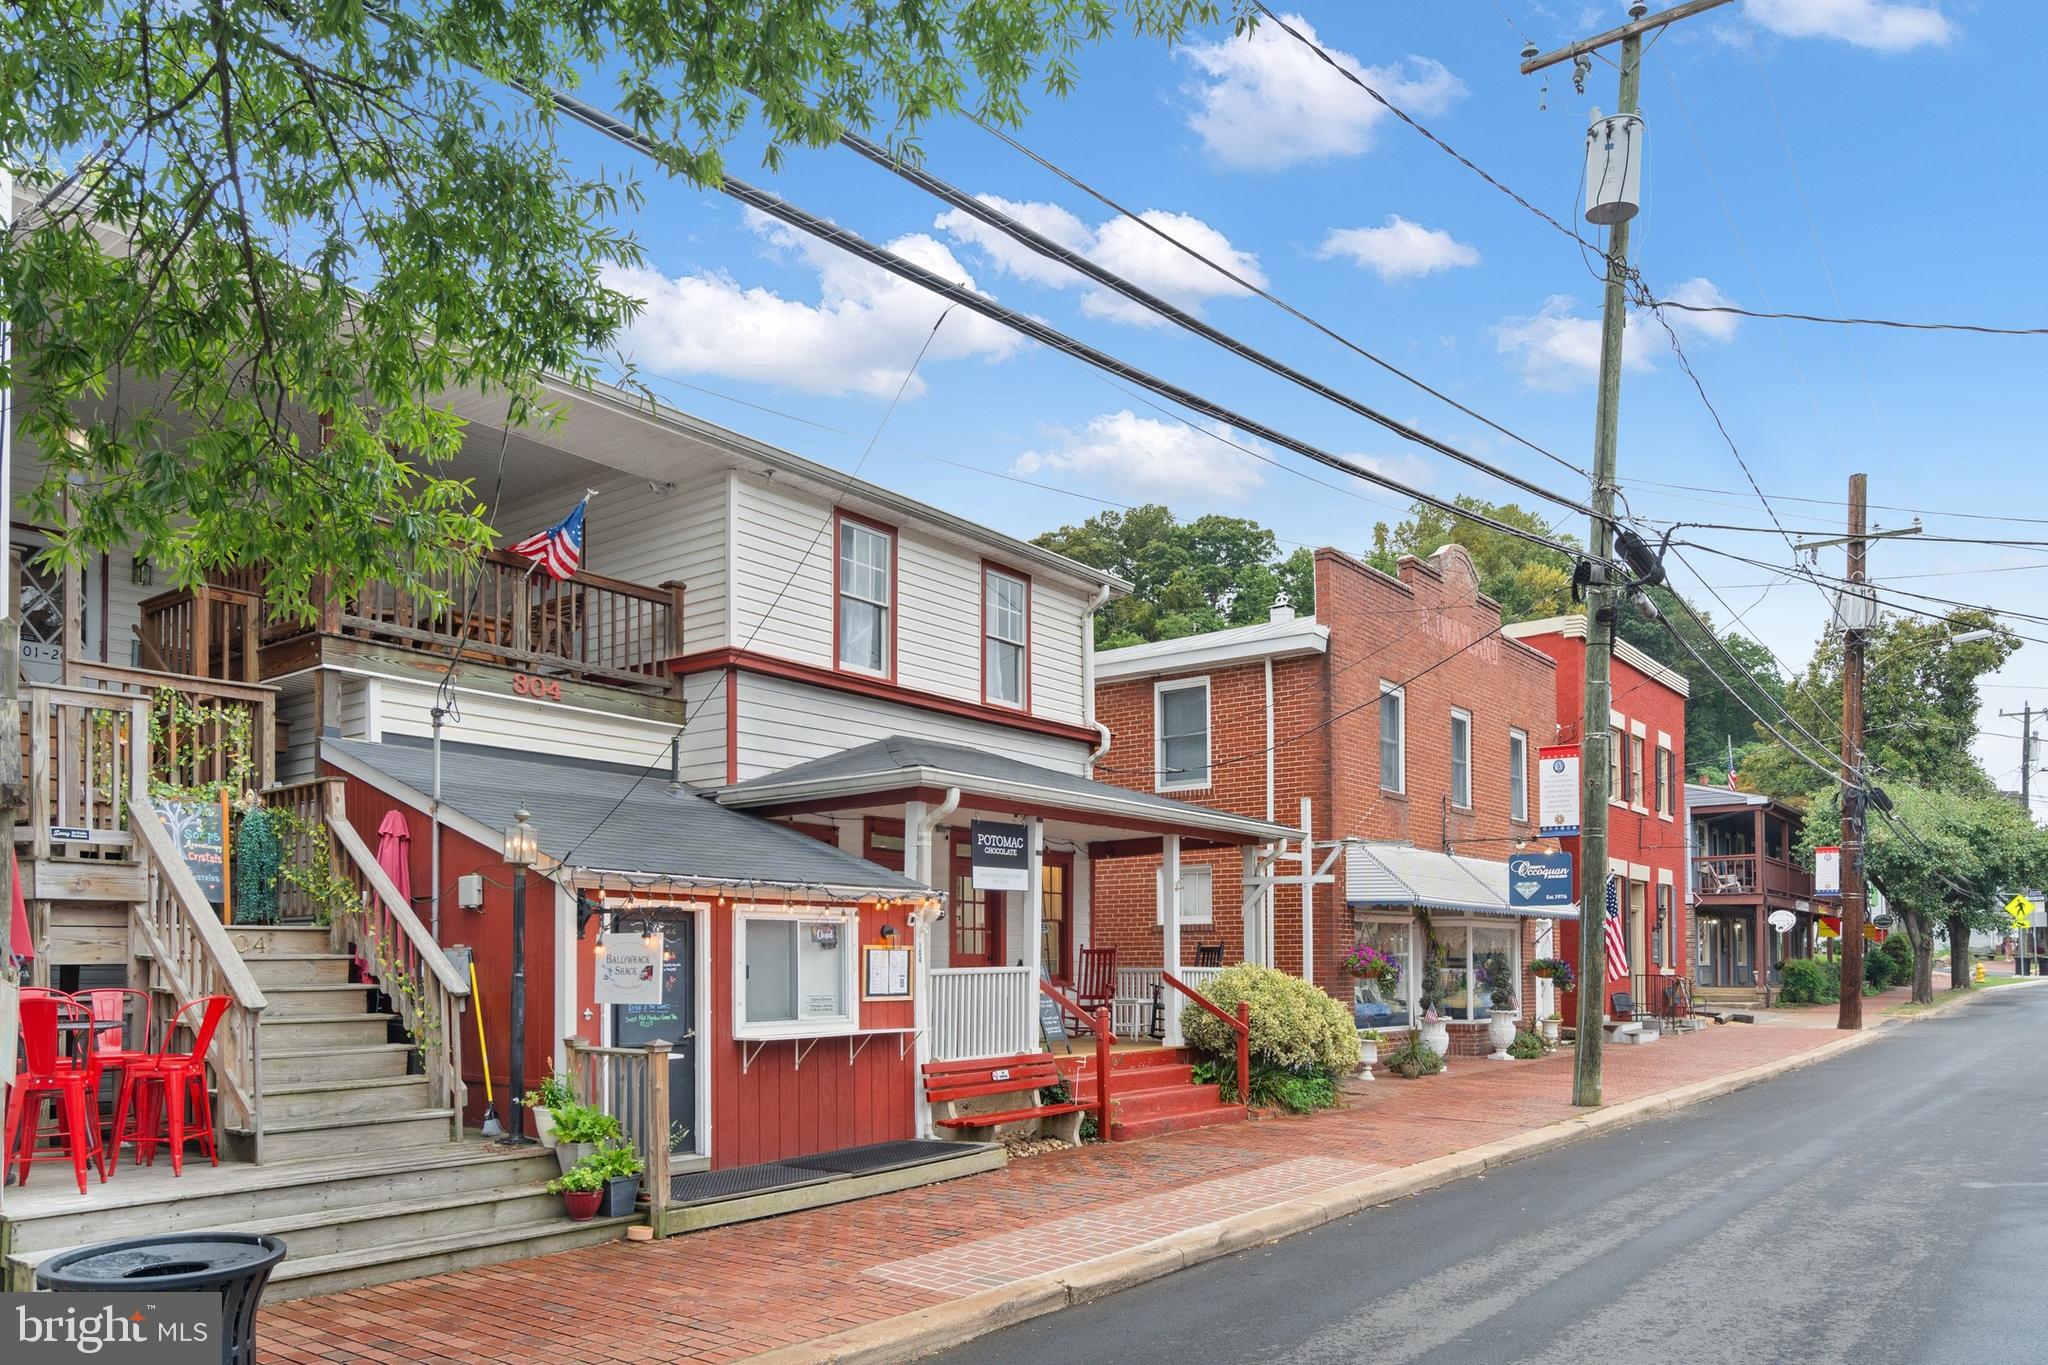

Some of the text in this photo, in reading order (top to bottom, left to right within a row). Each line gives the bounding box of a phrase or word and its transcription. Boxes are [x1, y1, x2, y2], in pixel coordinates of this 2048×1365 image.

[23, 645, 63, 659] 01-2
[513, 672, 561, 701] 304
[977, 833, 1024, 848] POTOMAC
[188, 852, 223, 864] Crystals
[984, 846, 1018, 857] CHOCOLATE
[1510, 860, 1570, 880] Occoquan
[606, 953, 651, 964] BALLYWHACK
[615, 965, 637, 976] SHACK
